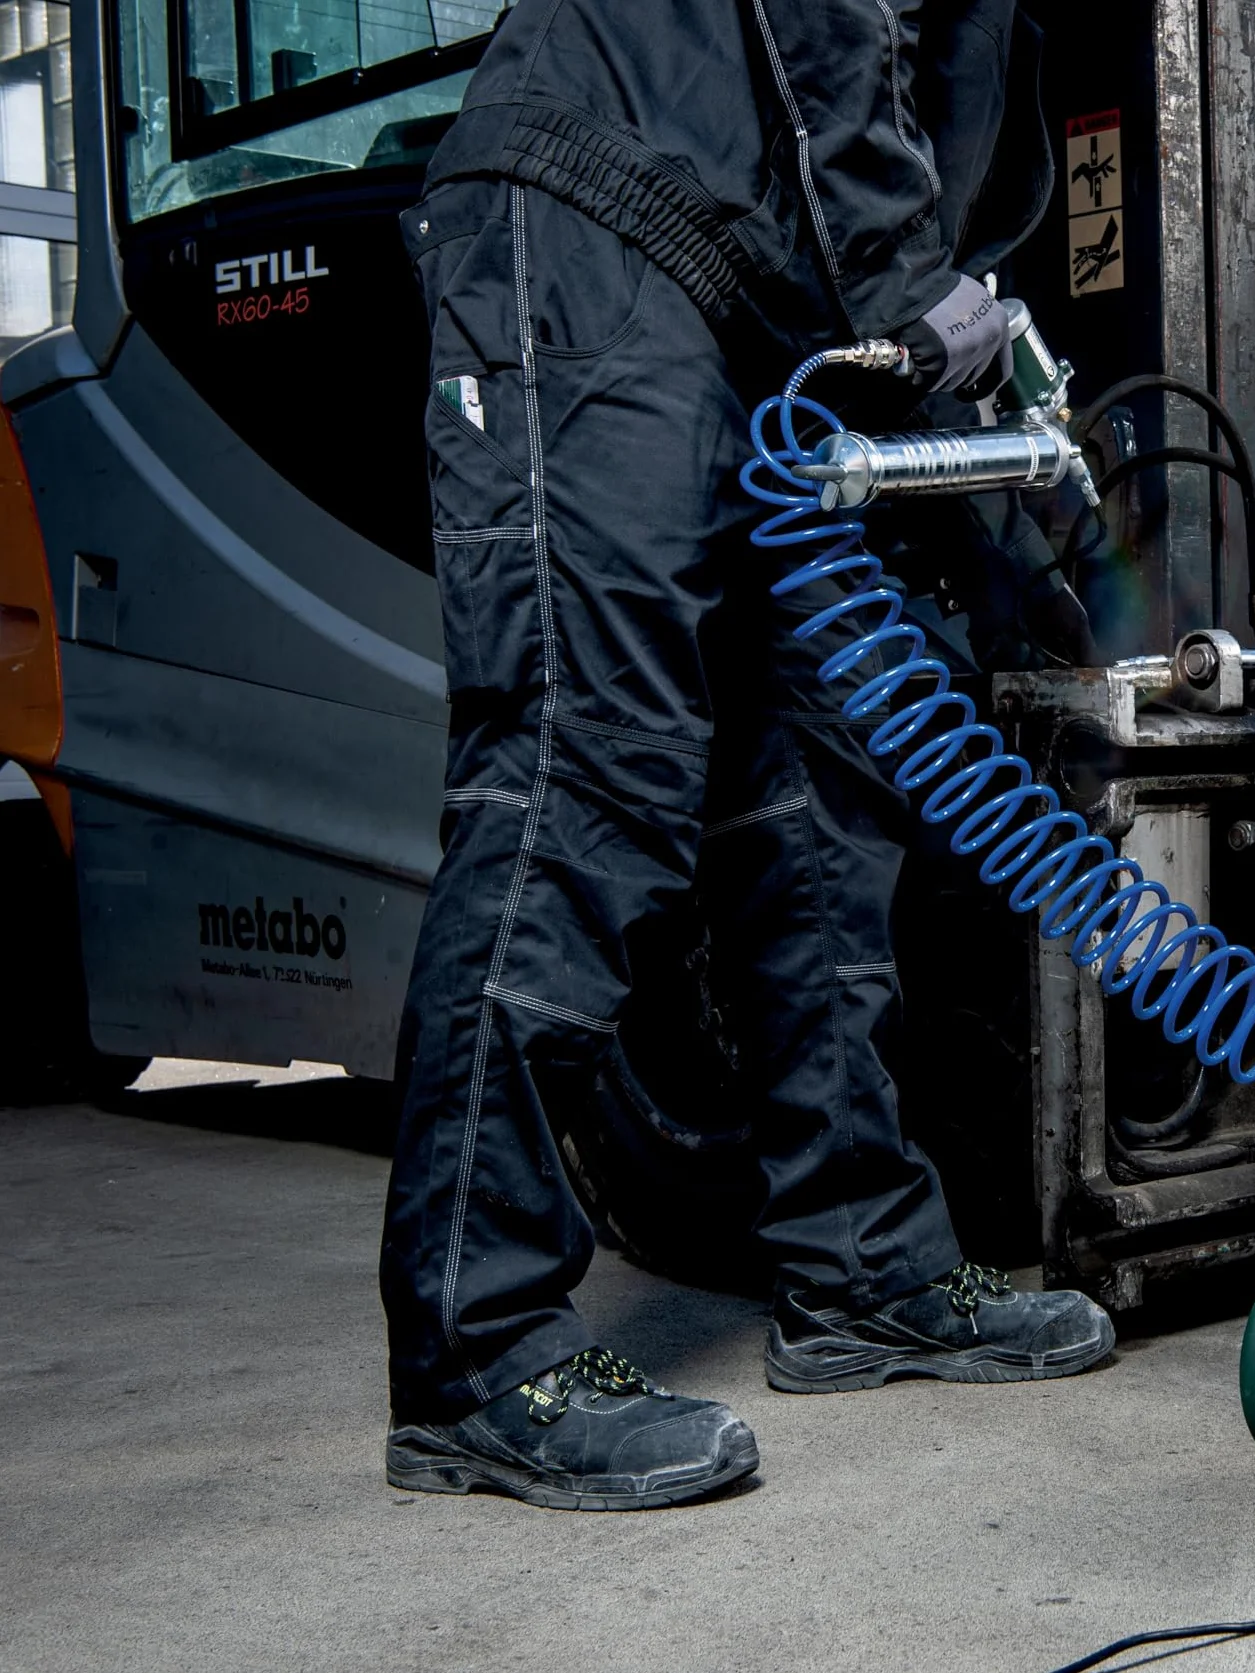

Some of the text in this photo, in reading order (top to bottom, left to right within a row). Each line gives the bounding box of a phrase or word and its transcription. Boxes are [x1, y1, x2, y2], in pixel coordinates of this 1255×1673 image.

[215, 245, 330, 295] STILL
[217, 287, 310, 326] RX60-45
[946, 293, 995, 335] metab
[198, 896, 348, 960] metabo
[304, 969, 353, 992] Nürtingen
